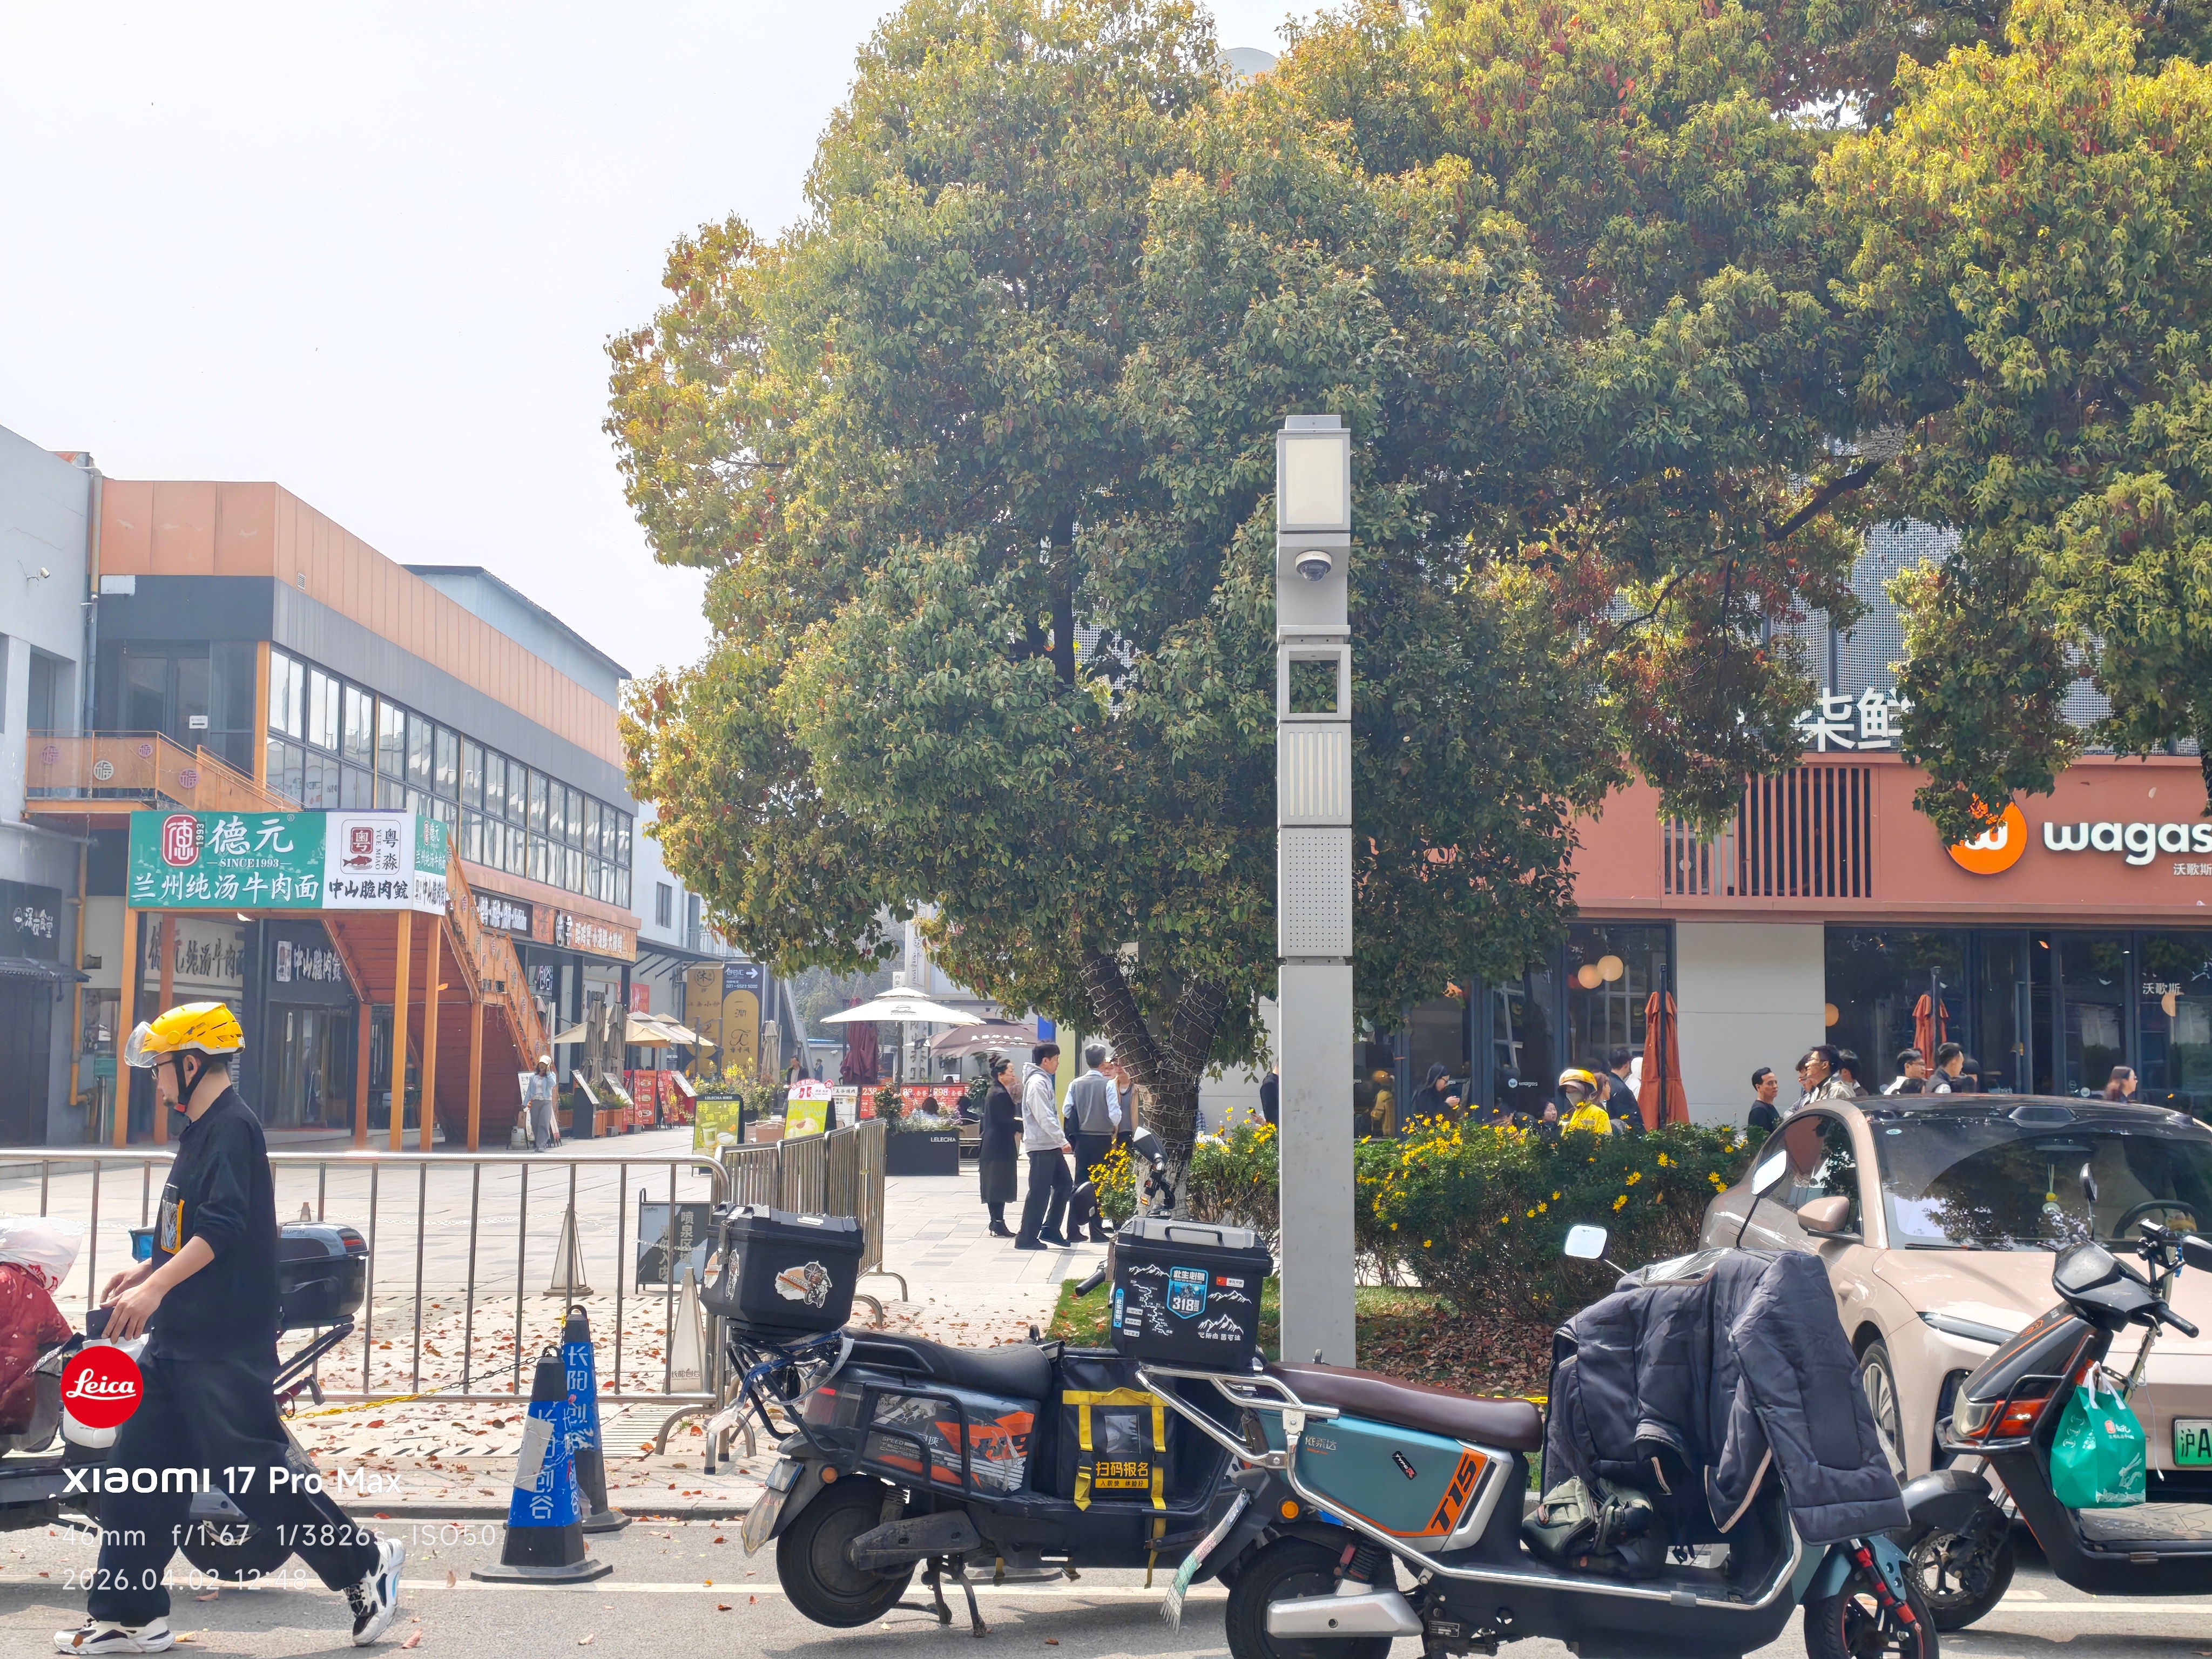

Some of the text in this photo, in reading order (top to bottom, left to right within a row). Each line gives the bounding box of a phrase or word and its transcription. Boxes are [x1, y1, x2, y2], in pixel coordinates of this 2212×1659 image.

[196, 824, 205, 846] 1993
[208, 815, 293, 855] 德元
[353, 830, 370, 852] 粤
[2044, 821, 2212, 865] wagas
[382, 828, 399, 871] 粤淼
[2173, 863, 2212, 876] 沃歌斯
[131, 871, 319, 905] 兰州纯汤牛肉面
[1172, 1297, 1195, 1311] 318
[2180, 1428, 2212, 1458] 沪A
[1096, 1461, 1148, 1476] 扫码报名
